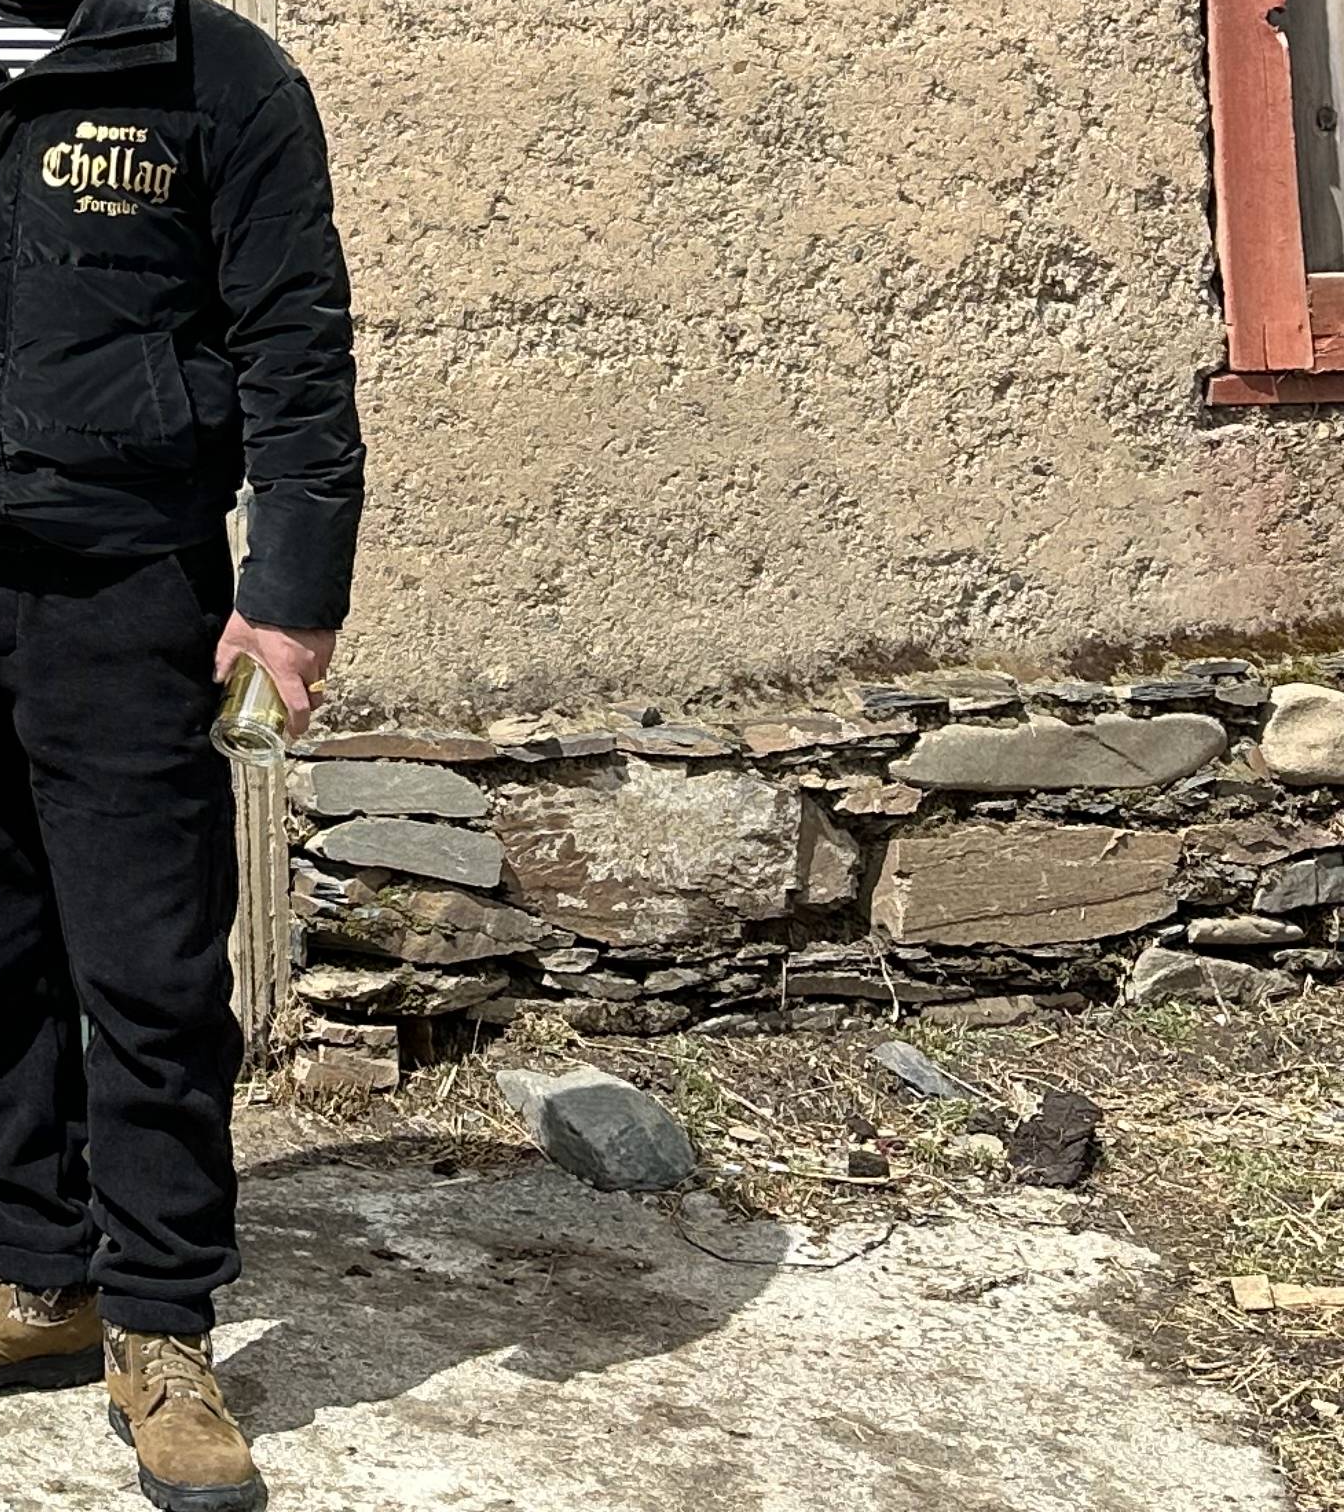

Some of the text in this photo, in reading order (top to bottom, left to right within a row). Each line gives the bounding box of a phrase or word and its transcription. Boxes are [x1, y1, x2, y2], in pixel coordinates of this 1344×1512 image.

[74, 121, 148, 143] Sports
[42, 142, 177, 203] Chellag
[73, 194, 139, 216] Forgive
